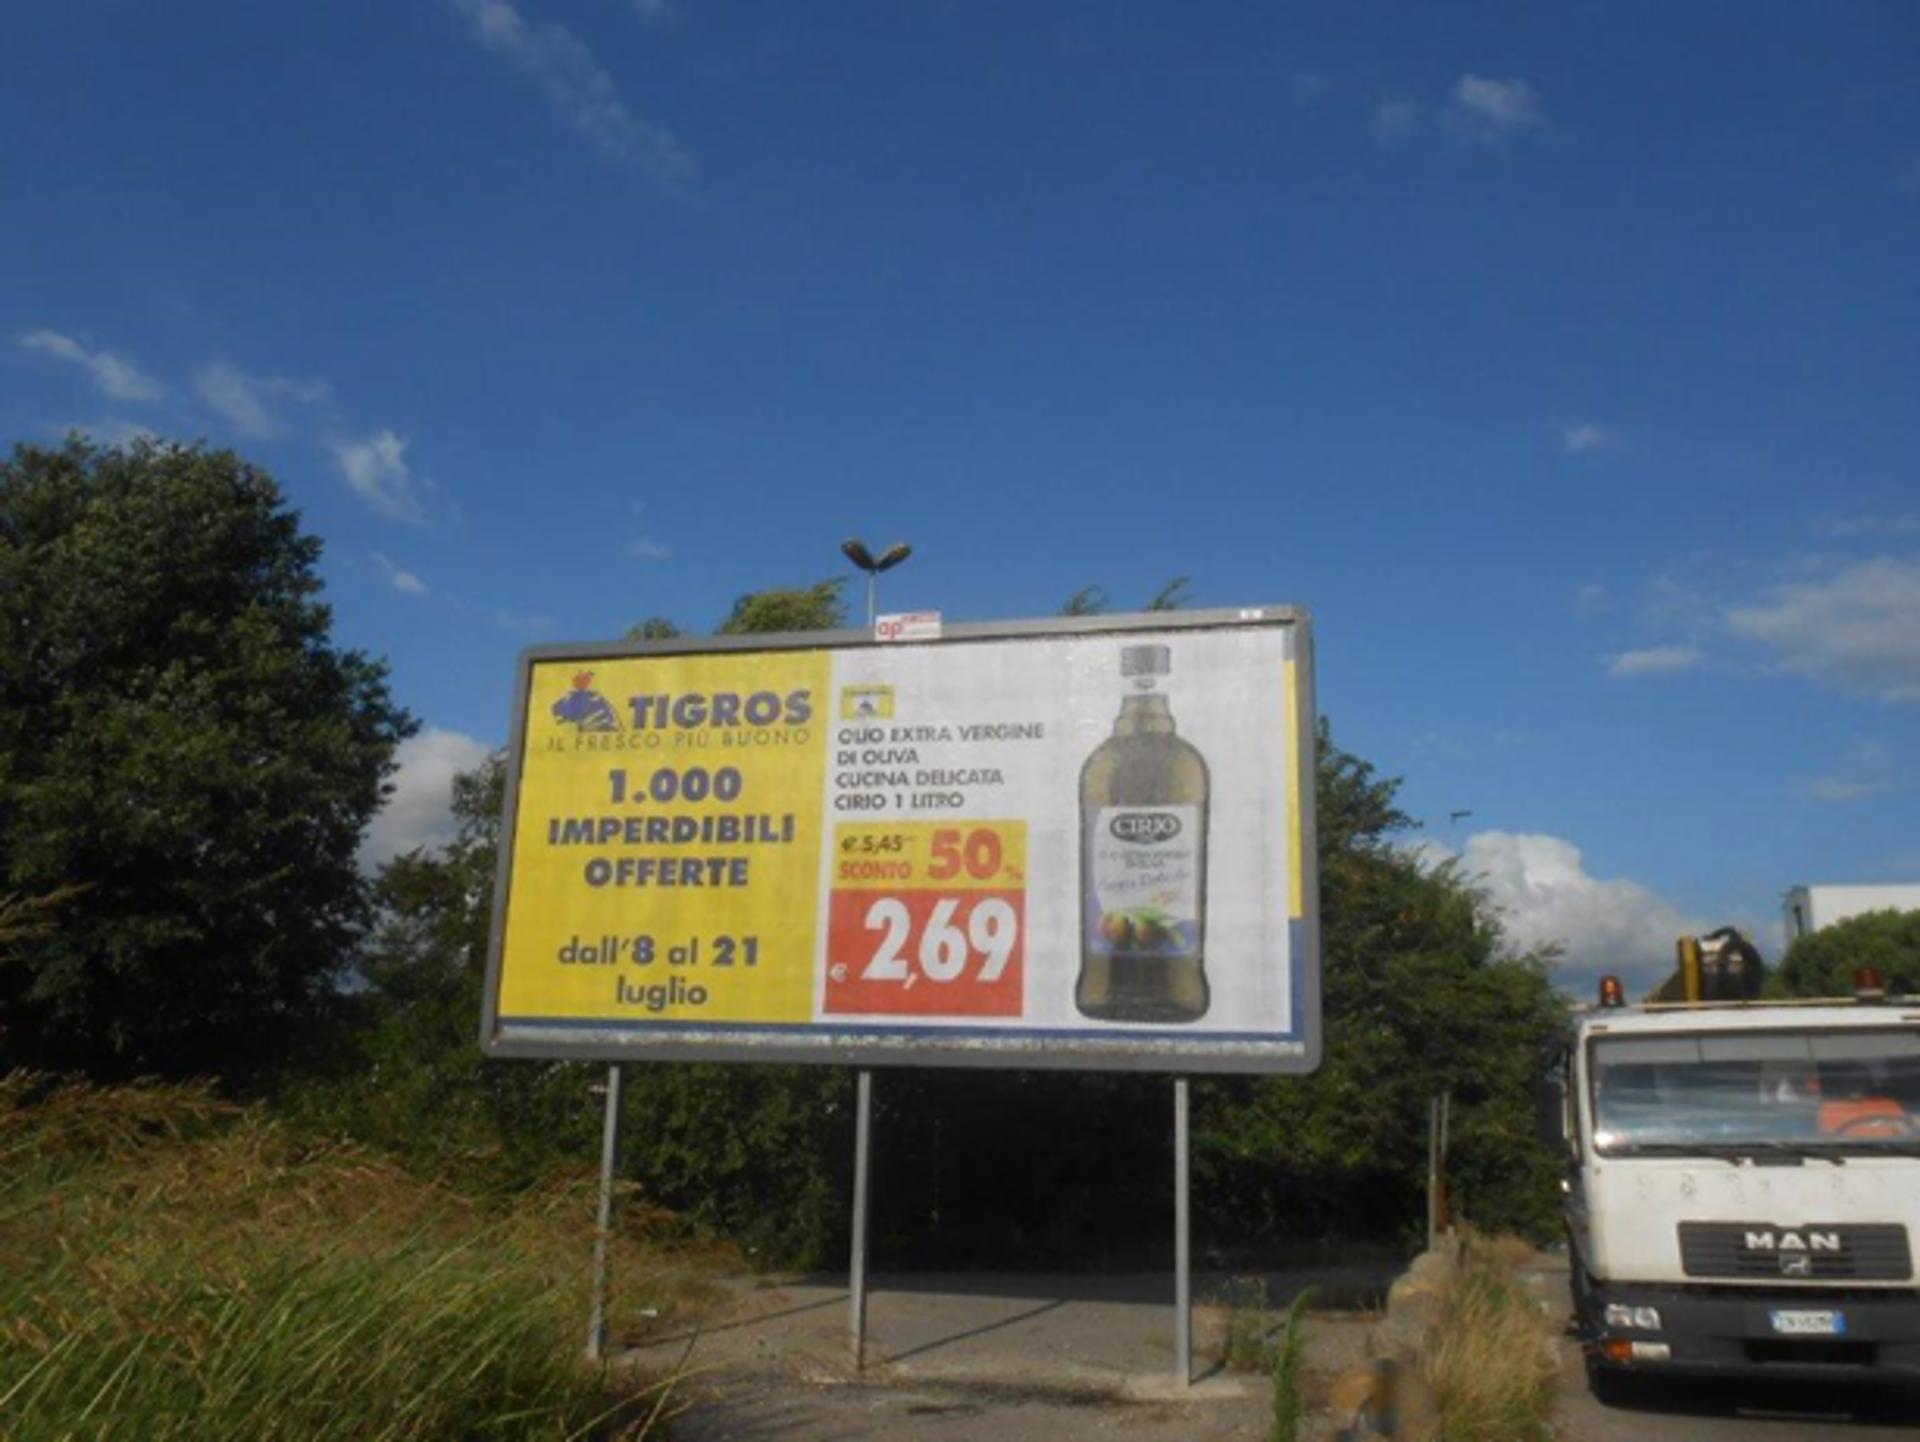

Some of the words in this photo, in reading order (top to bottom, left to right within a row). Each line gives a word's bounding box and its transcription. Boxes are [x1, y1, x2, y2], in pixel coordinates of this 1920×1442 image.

[629, 690, 812, 730] TIGROS
[547, 736, 565, 752] IL
[575, 731, 661, 751] FRESCO
[722, 729, 811, 747] BUONO
[837, 728, 885, 745] OLIO
[890, 725, 952, 743] EXTRA
[957, 722, 1046, 742] VERGINE
[836, 749, 857, 766] DI
[861, 748, 920, 765] OLIVA
[608, 766, 743, 804] 1.000
[834, 770, 910, 788] CUCINA
[915, 768, 1005, 786] DELICATA
[833, 793, 887, 811] CIRIO
[894, 793, 903, 809] 1
[910, 791, 965, 809] LITRO
[548, 813, 795, 845] IMPERDIBILI
[583, 856, 748, 887] OFFERTE
[839, 861, 912, 880] SCONTO
[667, 937, 699, 965] al
[711, 934, 760, 966] 21
[860, 896, 1018, 990] 2,69
[615, 975, 708, 1011] luglio
[1744, 1231, 1840, 1251] MAN
